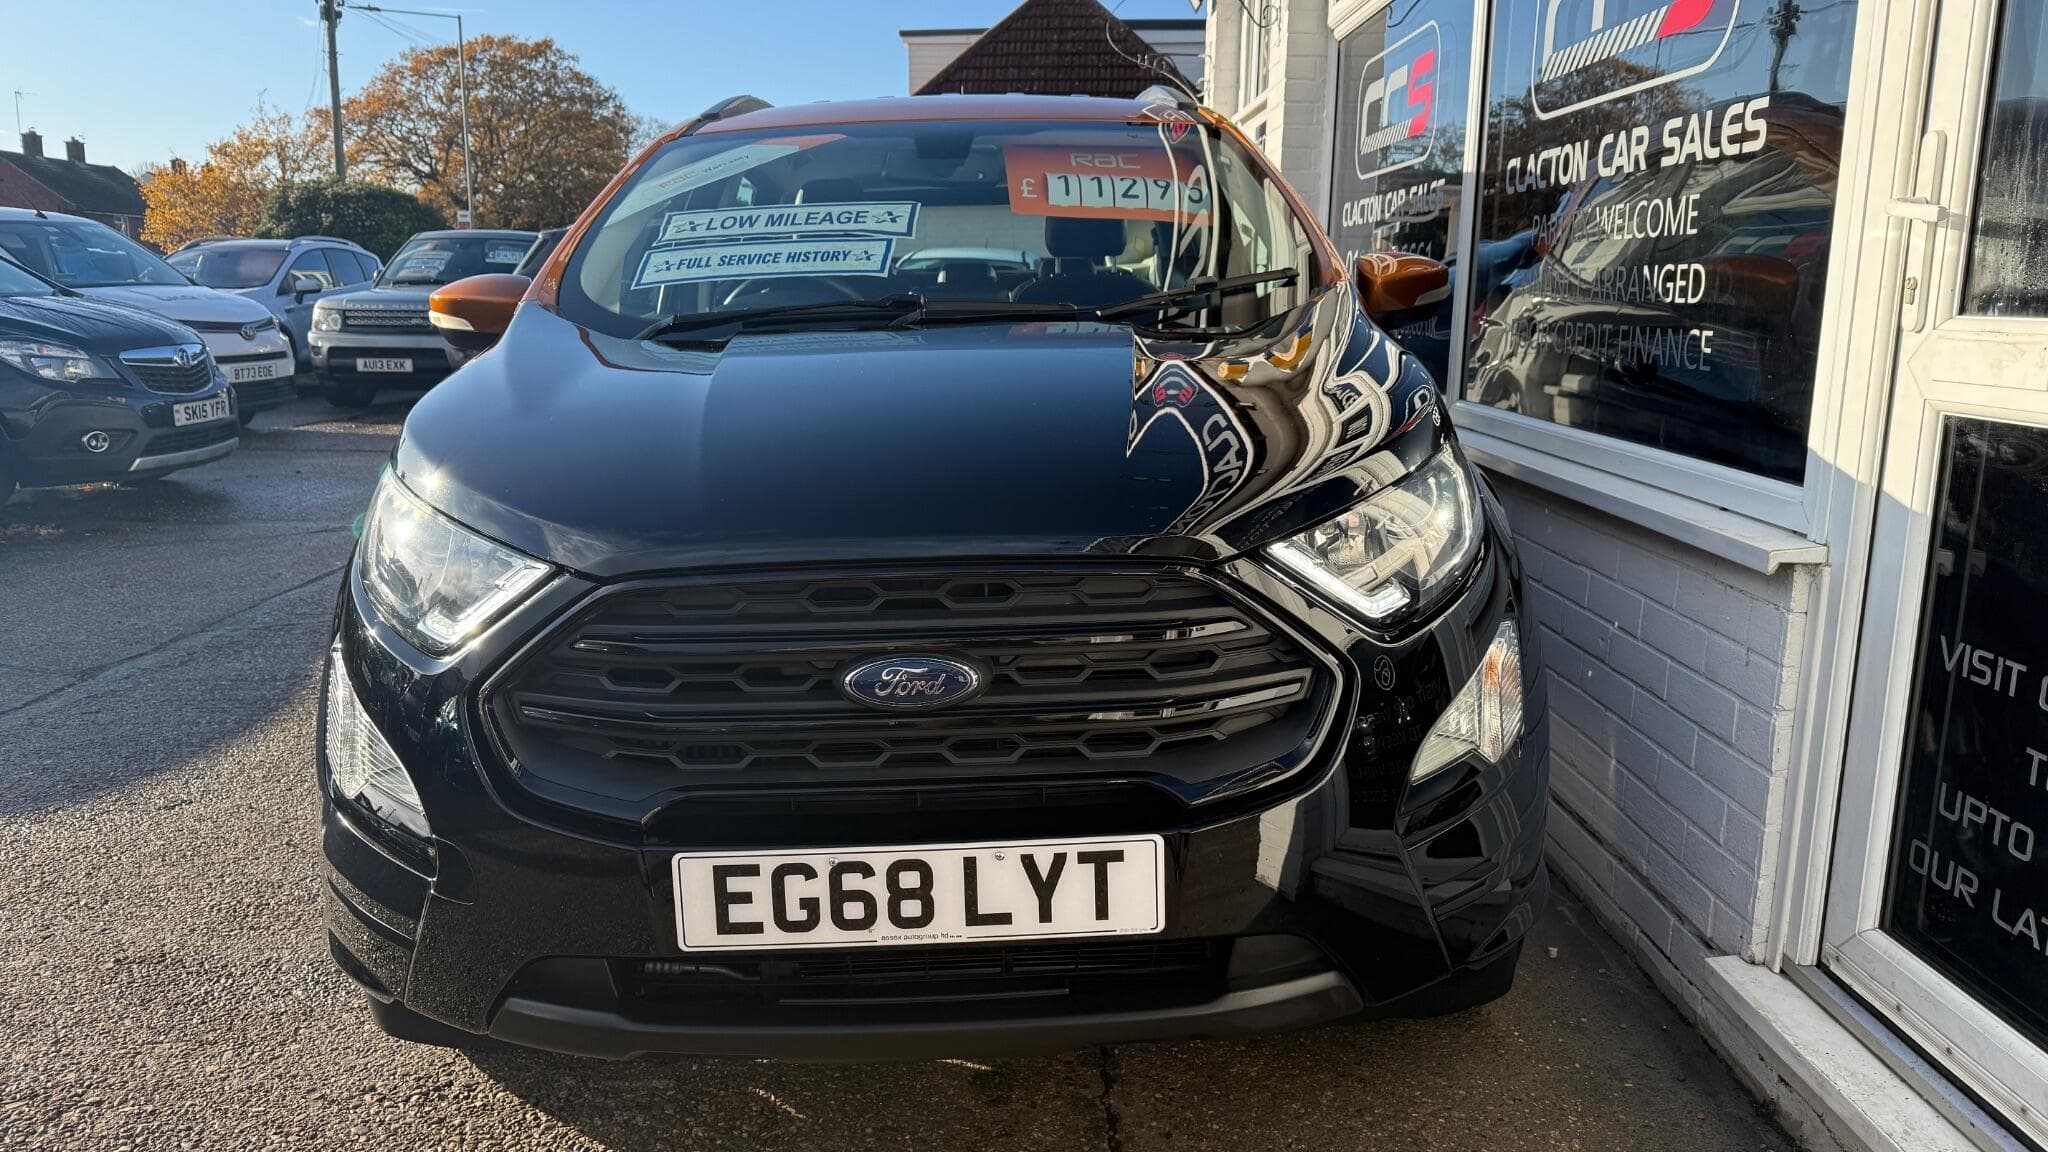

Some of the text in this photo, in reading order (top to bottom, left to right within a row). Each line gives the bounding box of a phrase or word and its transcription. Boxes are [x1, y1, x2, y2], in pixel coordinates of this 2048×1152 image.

[1506, 95, 1771, 195] CLACTON CAR SALES
[702, 152, 751, 174] Warranty
[1020, 177, 1038, 199] £
[705, 209, 870, 232] LOW MILEAGE
[1342, 193, 1381, 228] CLACTON
[1385, 188, 1406, 221] CAR
[1595, 193, 1700, 241] WELCOME
[676, 248, 853, 271] FULL SERVICE HISTORY
[1590, 263, 1706, 304] ARRANGED
[1553, 320, 1613, 358] CREDIT
[1618, 323, 1715, 372] FINANCE
[234, 366, 257, 380] BT73
[363, 359, 406, 370] AU13 EXK
[184, 400, 228, 421] SK15 YFR
[875, 667, 948, 698] Ford
[1939, 635, 2028, 698] VISIT
[1938, 782, 2035, 863] UPTO
[1908, 838, 1980, 909] OUR
[712, 849, 1126, 936] EG68 LYT
[903, 931, 939, 942] autogroup
